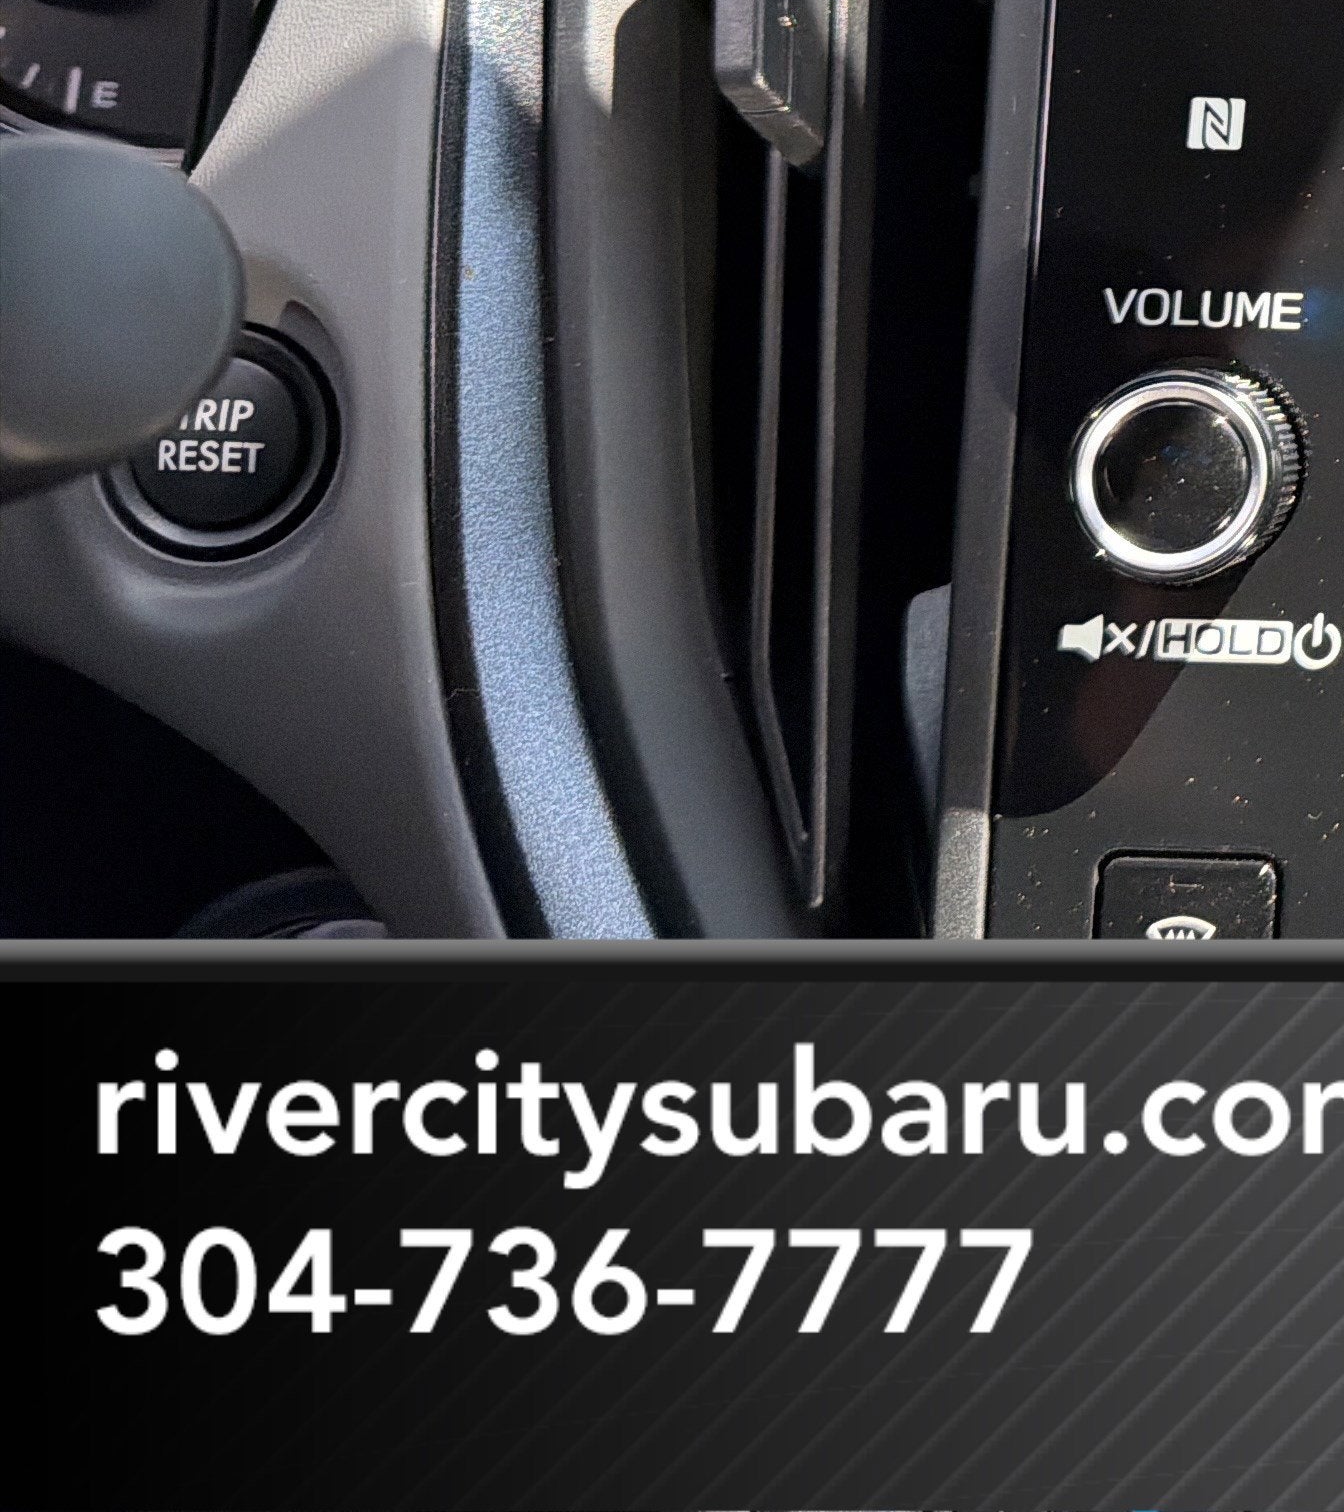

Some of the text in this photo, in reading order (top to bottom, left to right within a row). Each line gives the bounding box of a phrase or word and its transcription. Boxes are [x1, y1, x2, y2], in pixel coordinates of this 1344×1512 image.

[90, 80, 120, 110] E
[1103, 288, 1306, 331] VOLUME
[157, 439, 266, 474] RESET
